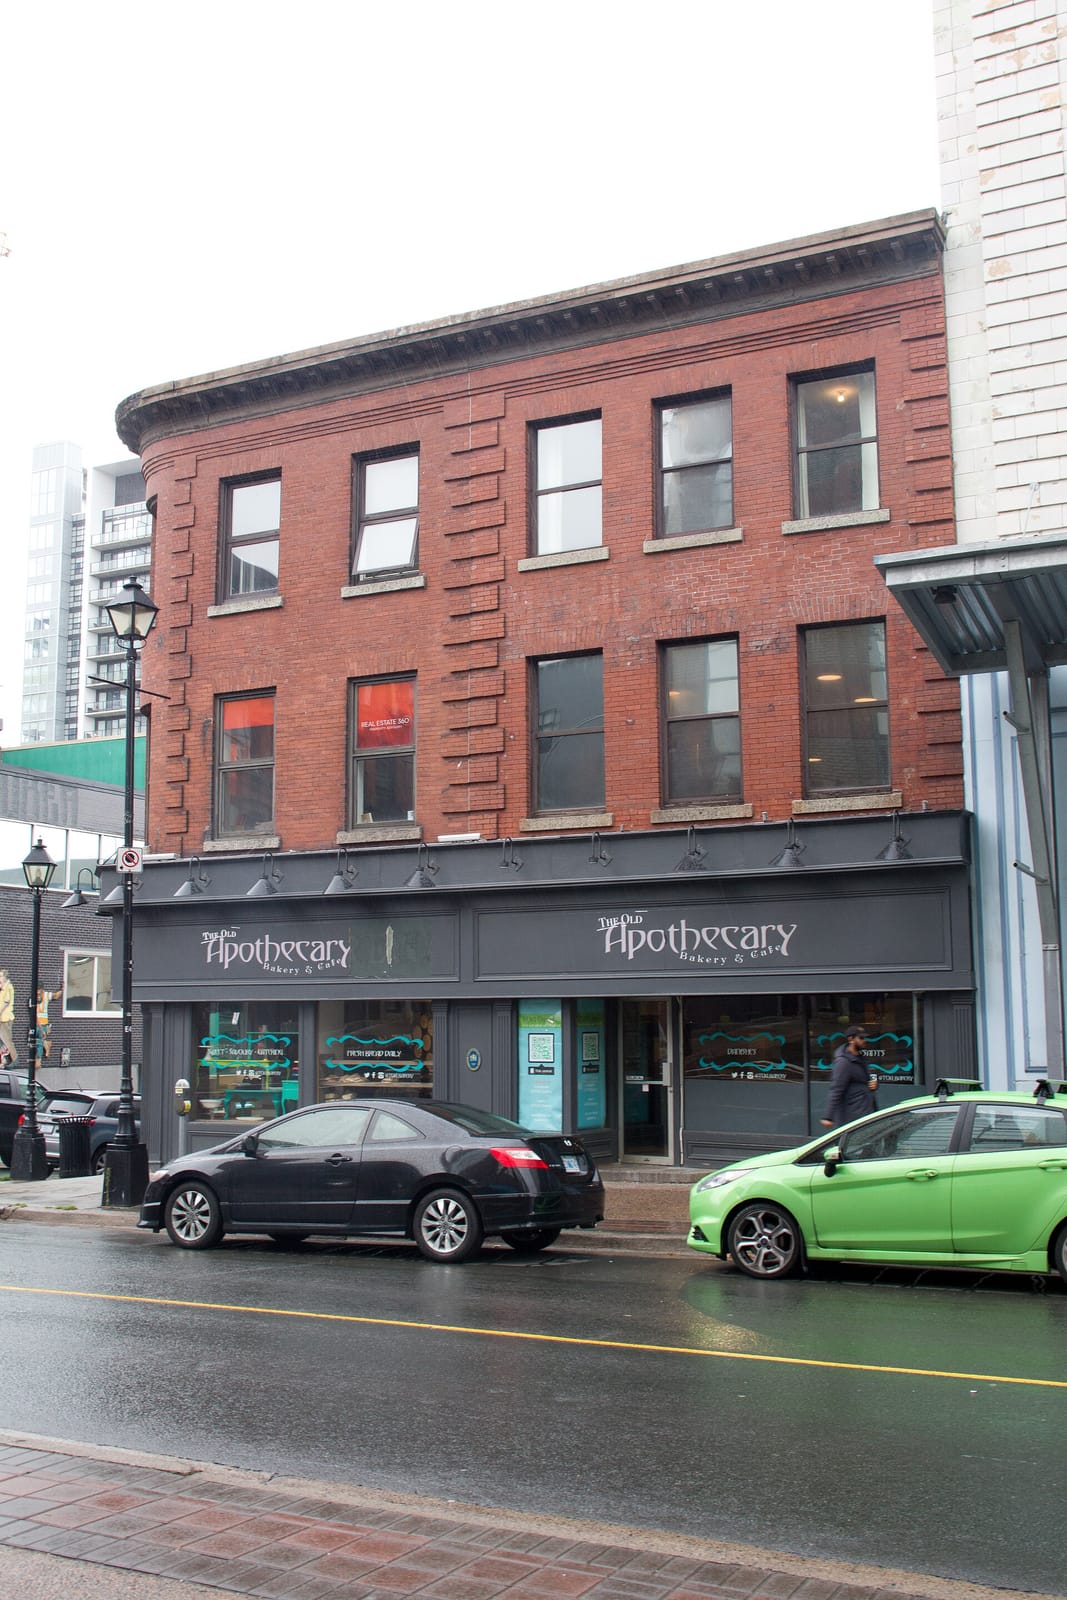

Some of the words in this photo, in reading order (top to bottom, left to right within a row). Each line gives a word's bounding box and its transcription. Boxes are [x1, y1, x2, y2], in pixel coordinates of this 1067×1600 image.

[376, 718, 396, 727] ESTATE
[397, 717, 410, 725] 360
[597, 919, 798, 961] Apothecary
[200, 934, 351, 970] Apothecary
[679, 951, 728, 966] Bakery
[734, 953, 744, 963] &
[750, 944, 782, 959] Cafe
[263, 961, 300, 976] Bakery
[305, 965, 313, 975] &
